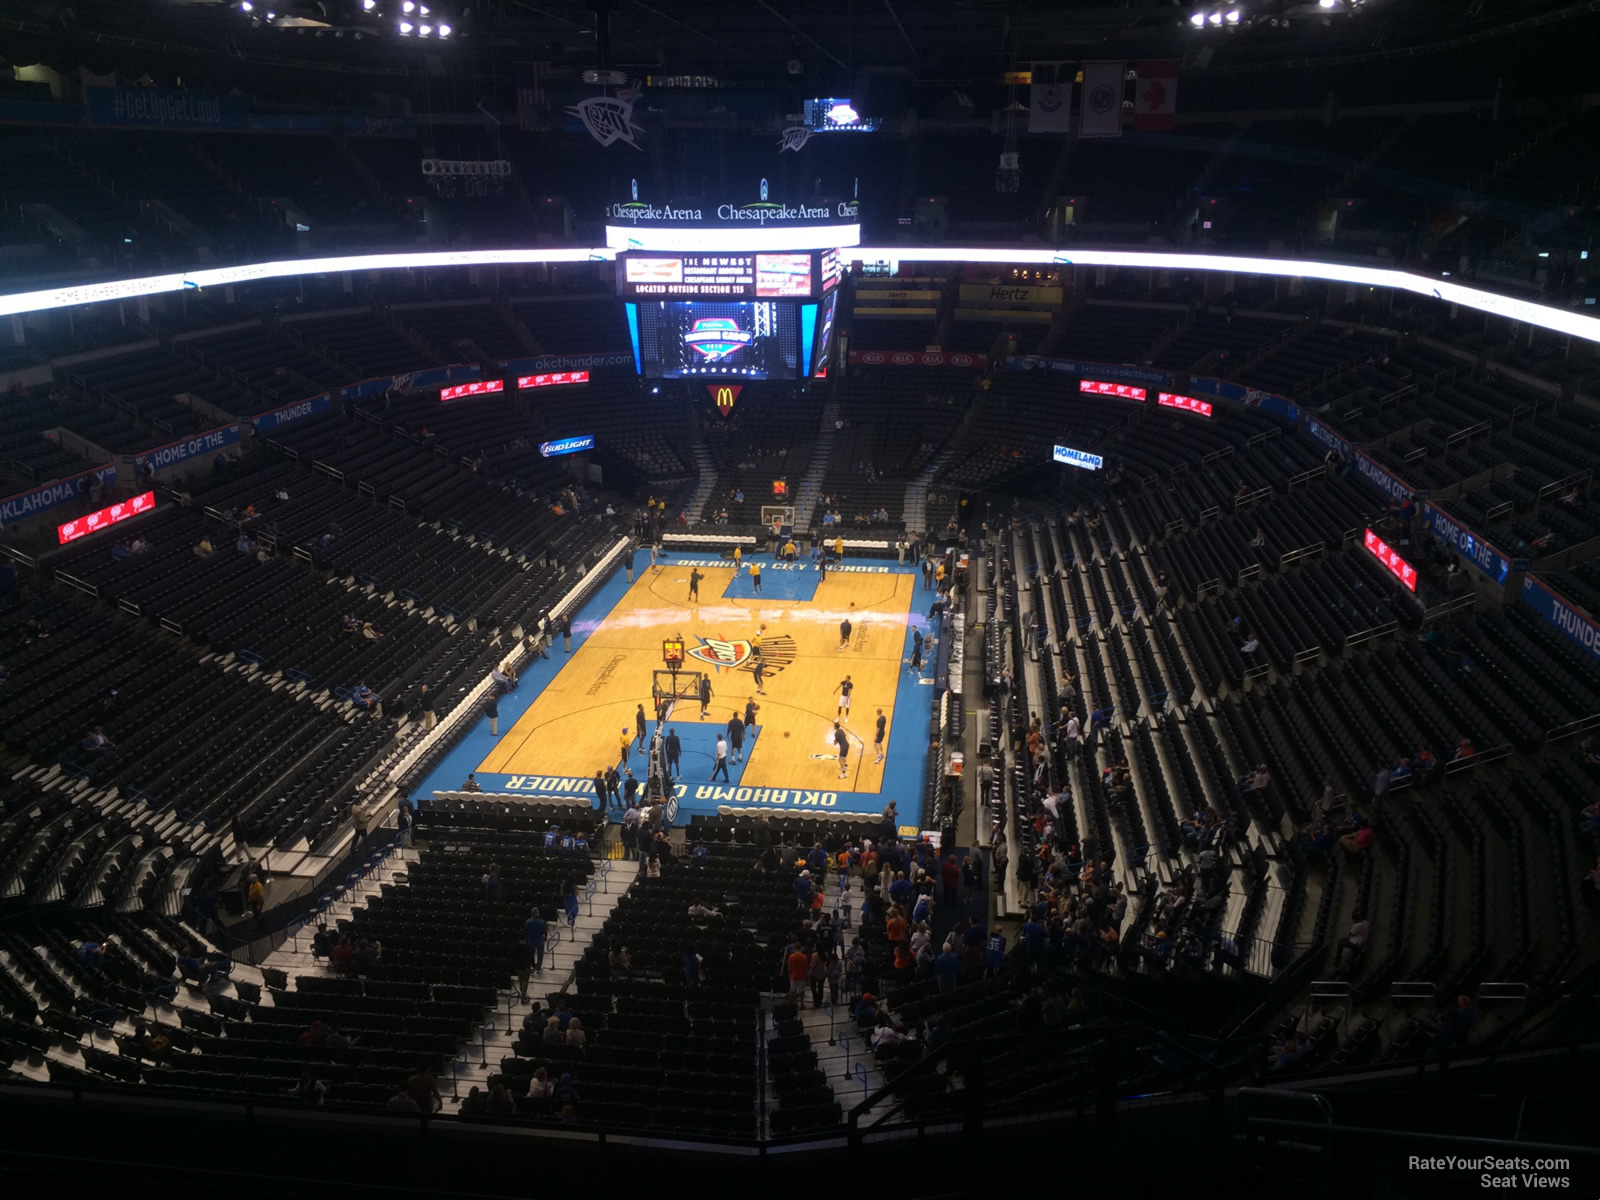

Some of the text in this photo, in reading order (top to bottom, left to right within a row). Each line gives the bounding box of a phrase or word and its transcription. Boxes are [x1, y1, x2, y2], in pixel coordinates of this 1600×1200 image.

[612, 203, 662, 224] Chesapeake
[663, 205, 702, 220] Arena
[717, 203, 830, 225] Chesapeake Arena
[702, 258, 752, 266] NEWEST
[636, 285, 666, 294] LOCATED
[668, 285, 699, 294] OUTSIDE
[701, 285, 731, 294] SECTION
[990, 287, 1028, 300] Hertz
[535, 353, 632, 370] okcthunder.com
[275, 402, 312, 424] THUNDER
[154, 431, 224, 466] HOME OF THE
[565, 439, 592, 450] LIGHT
[1055, 447, 1101, 466] HOMELAND
[1359, 457, 1392, 493] OKLAHOMA
[1435, 513, 1492, 569] HOME OF THE
[1523, 576, 1533, 590] 117
[695, 784, 838, 806] OKLAHOMA
